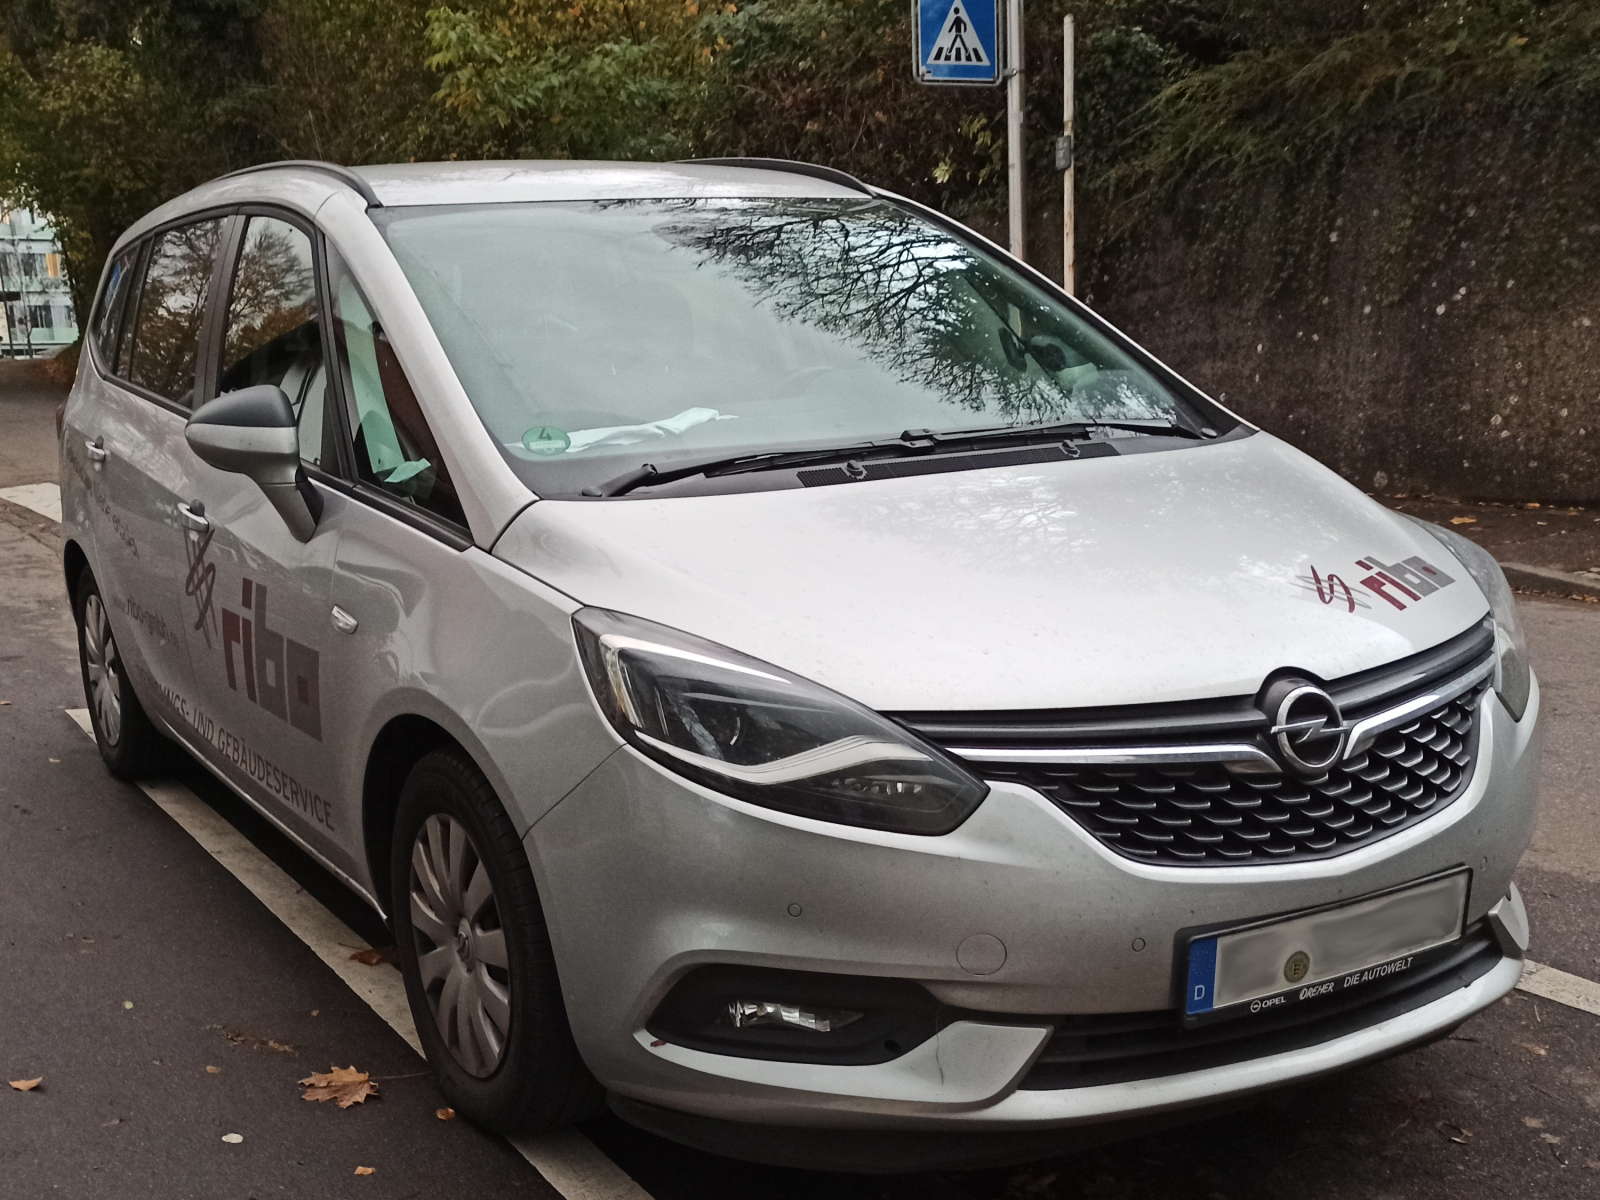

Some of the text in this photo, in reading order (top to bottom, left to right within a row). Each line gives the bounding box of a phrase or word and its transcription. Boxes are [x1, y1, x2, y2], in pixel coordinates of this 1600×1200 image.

[538, 427, 553, 440] 4
[1354, 555, 1456, 611] ribo
[221, 577, 323, 743] ribo
[192, 707, 335, 832] UND GEBÄUDESERVICE
[1194, 984, 1205, 1001] D
[1262, 996, 1286, 1009] OPEL
[1343, 972, 1361, 988] DIE
[1361, 956, 1414, 982] AUTOWELT
